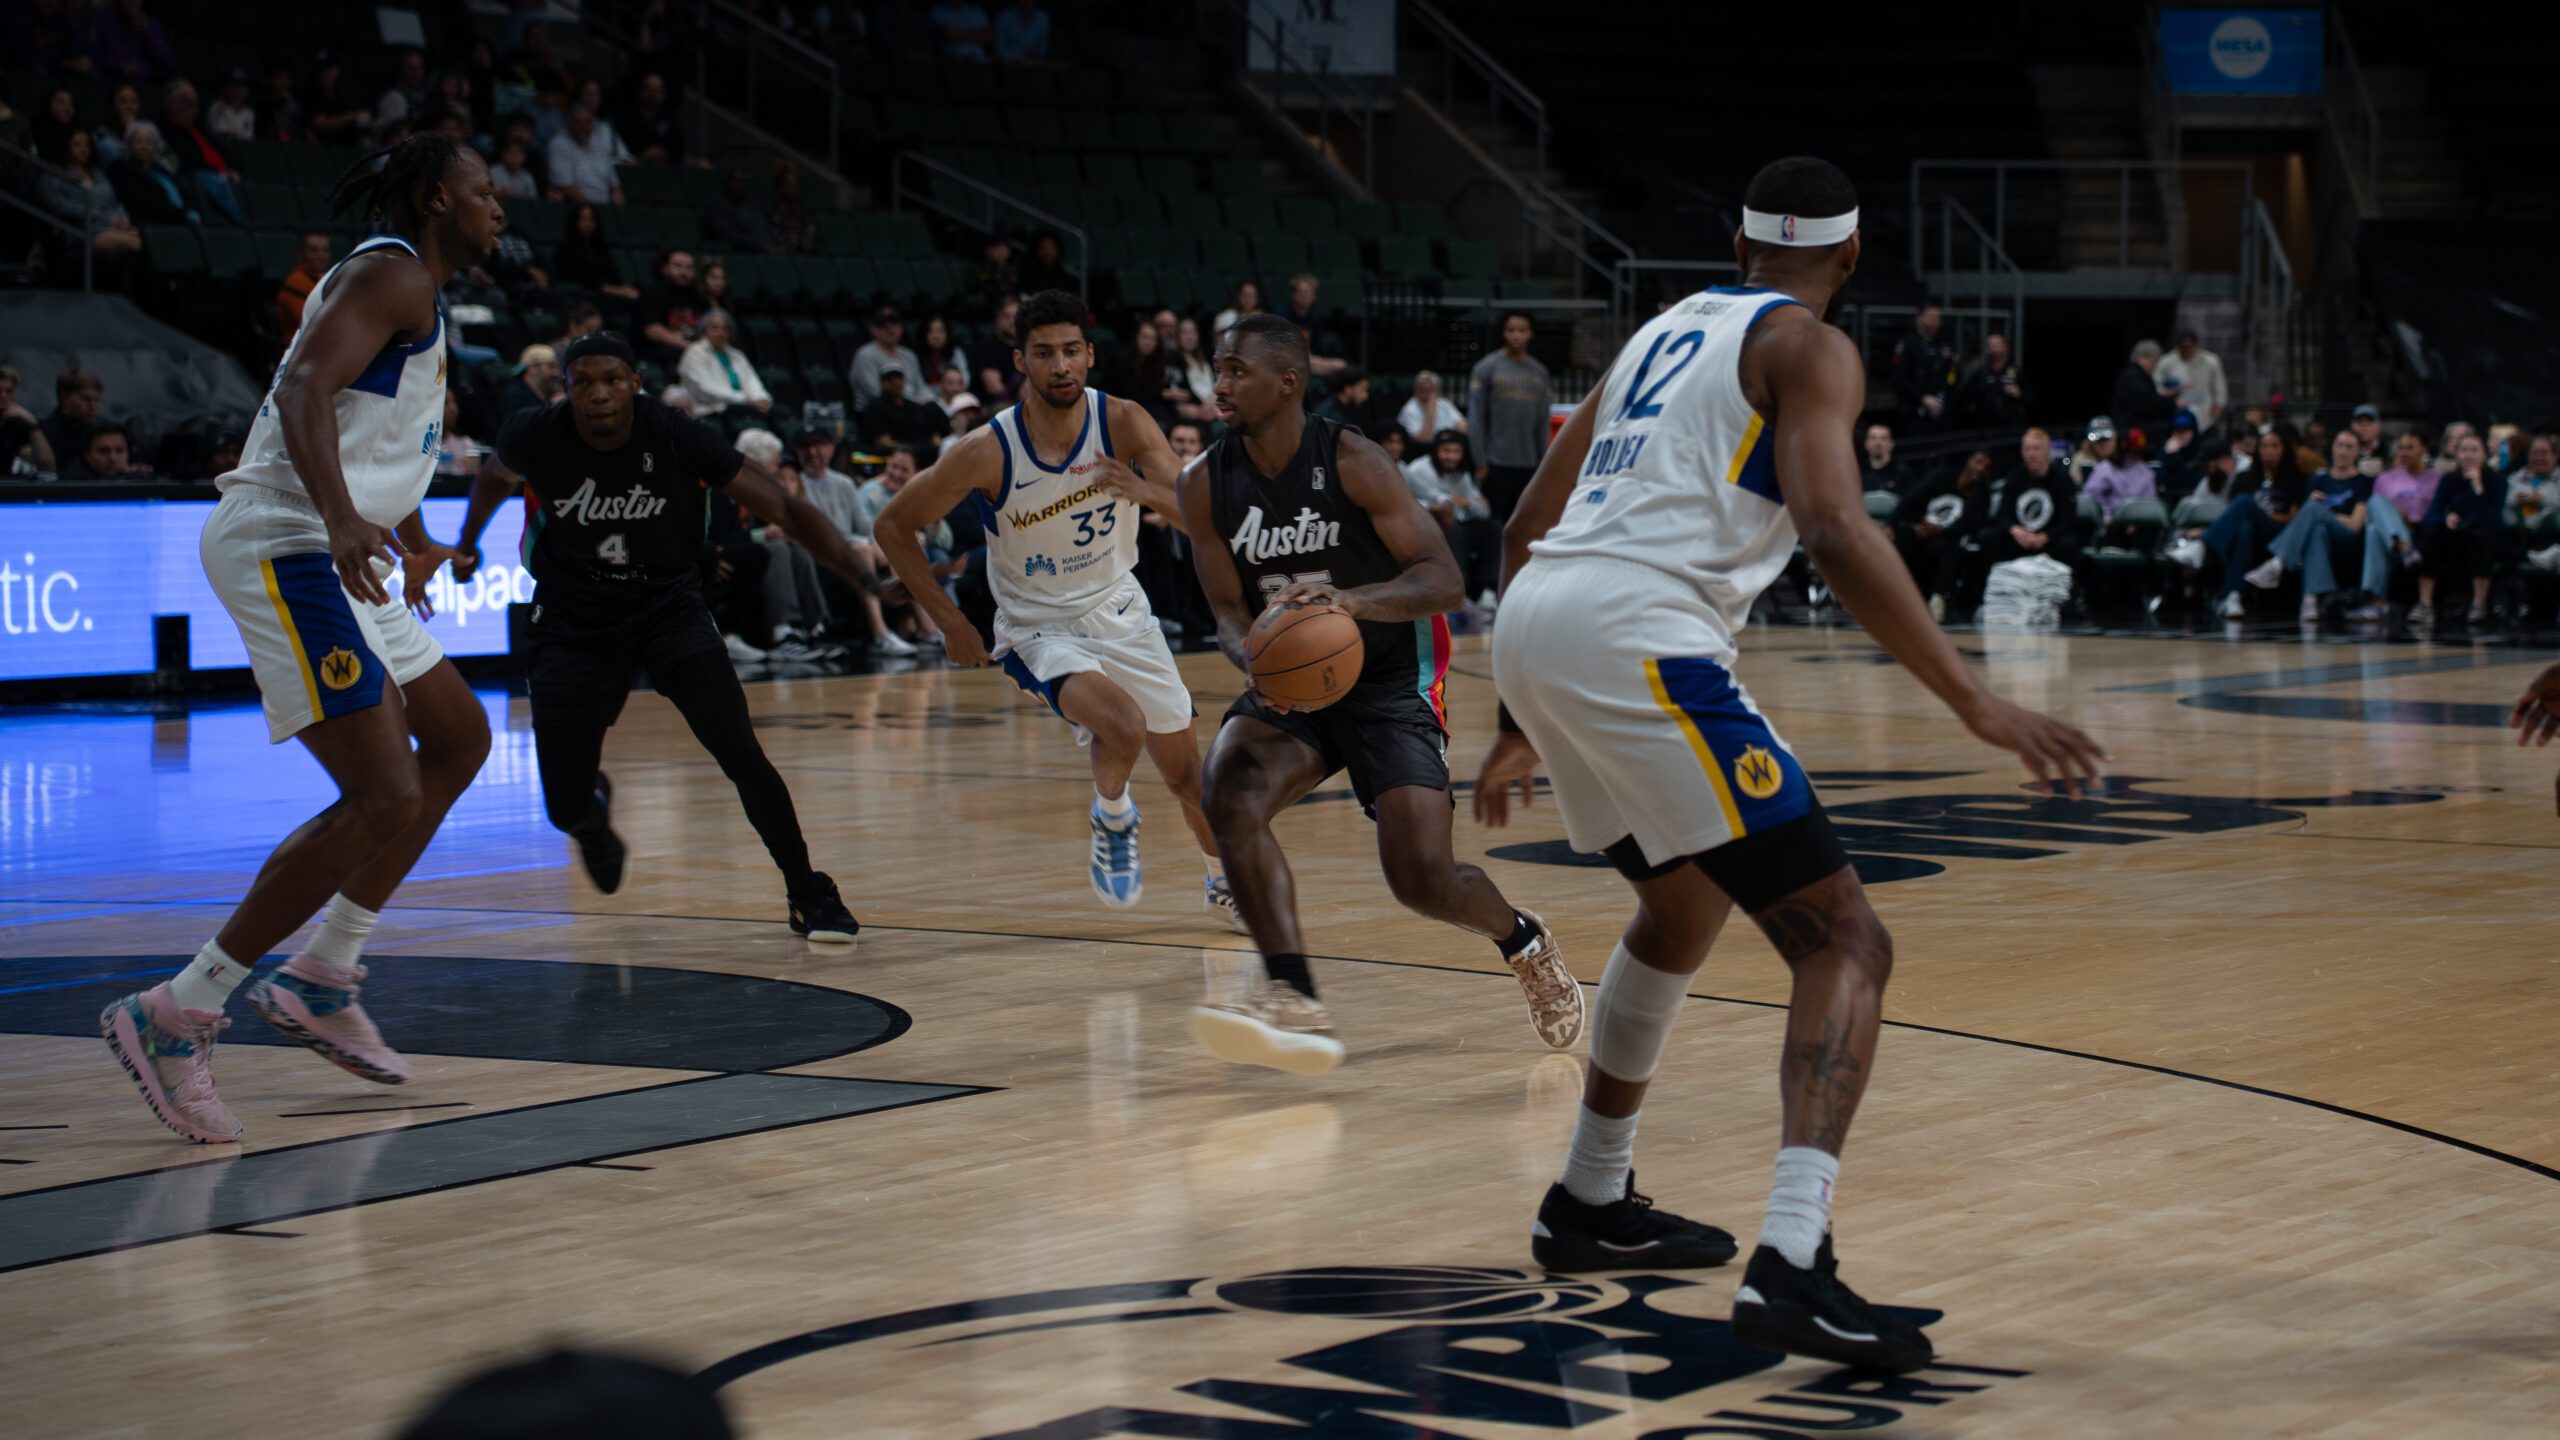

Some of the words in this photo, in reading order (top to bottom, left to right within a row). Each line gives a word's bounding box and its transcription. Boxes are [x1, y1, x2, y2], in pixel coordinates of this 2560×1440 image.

[1614, 329, 1705, 423] 12
[552, 476, 667, 527] Austin
[1006, 481, 1105, 531] WARRIOR
[1070, 501, 1116, 547] 33
[596, 532, 629, 566] 4
[1062, 551, 1092, 565] KAISER
[1229, 505, 1341, 566] Austin
